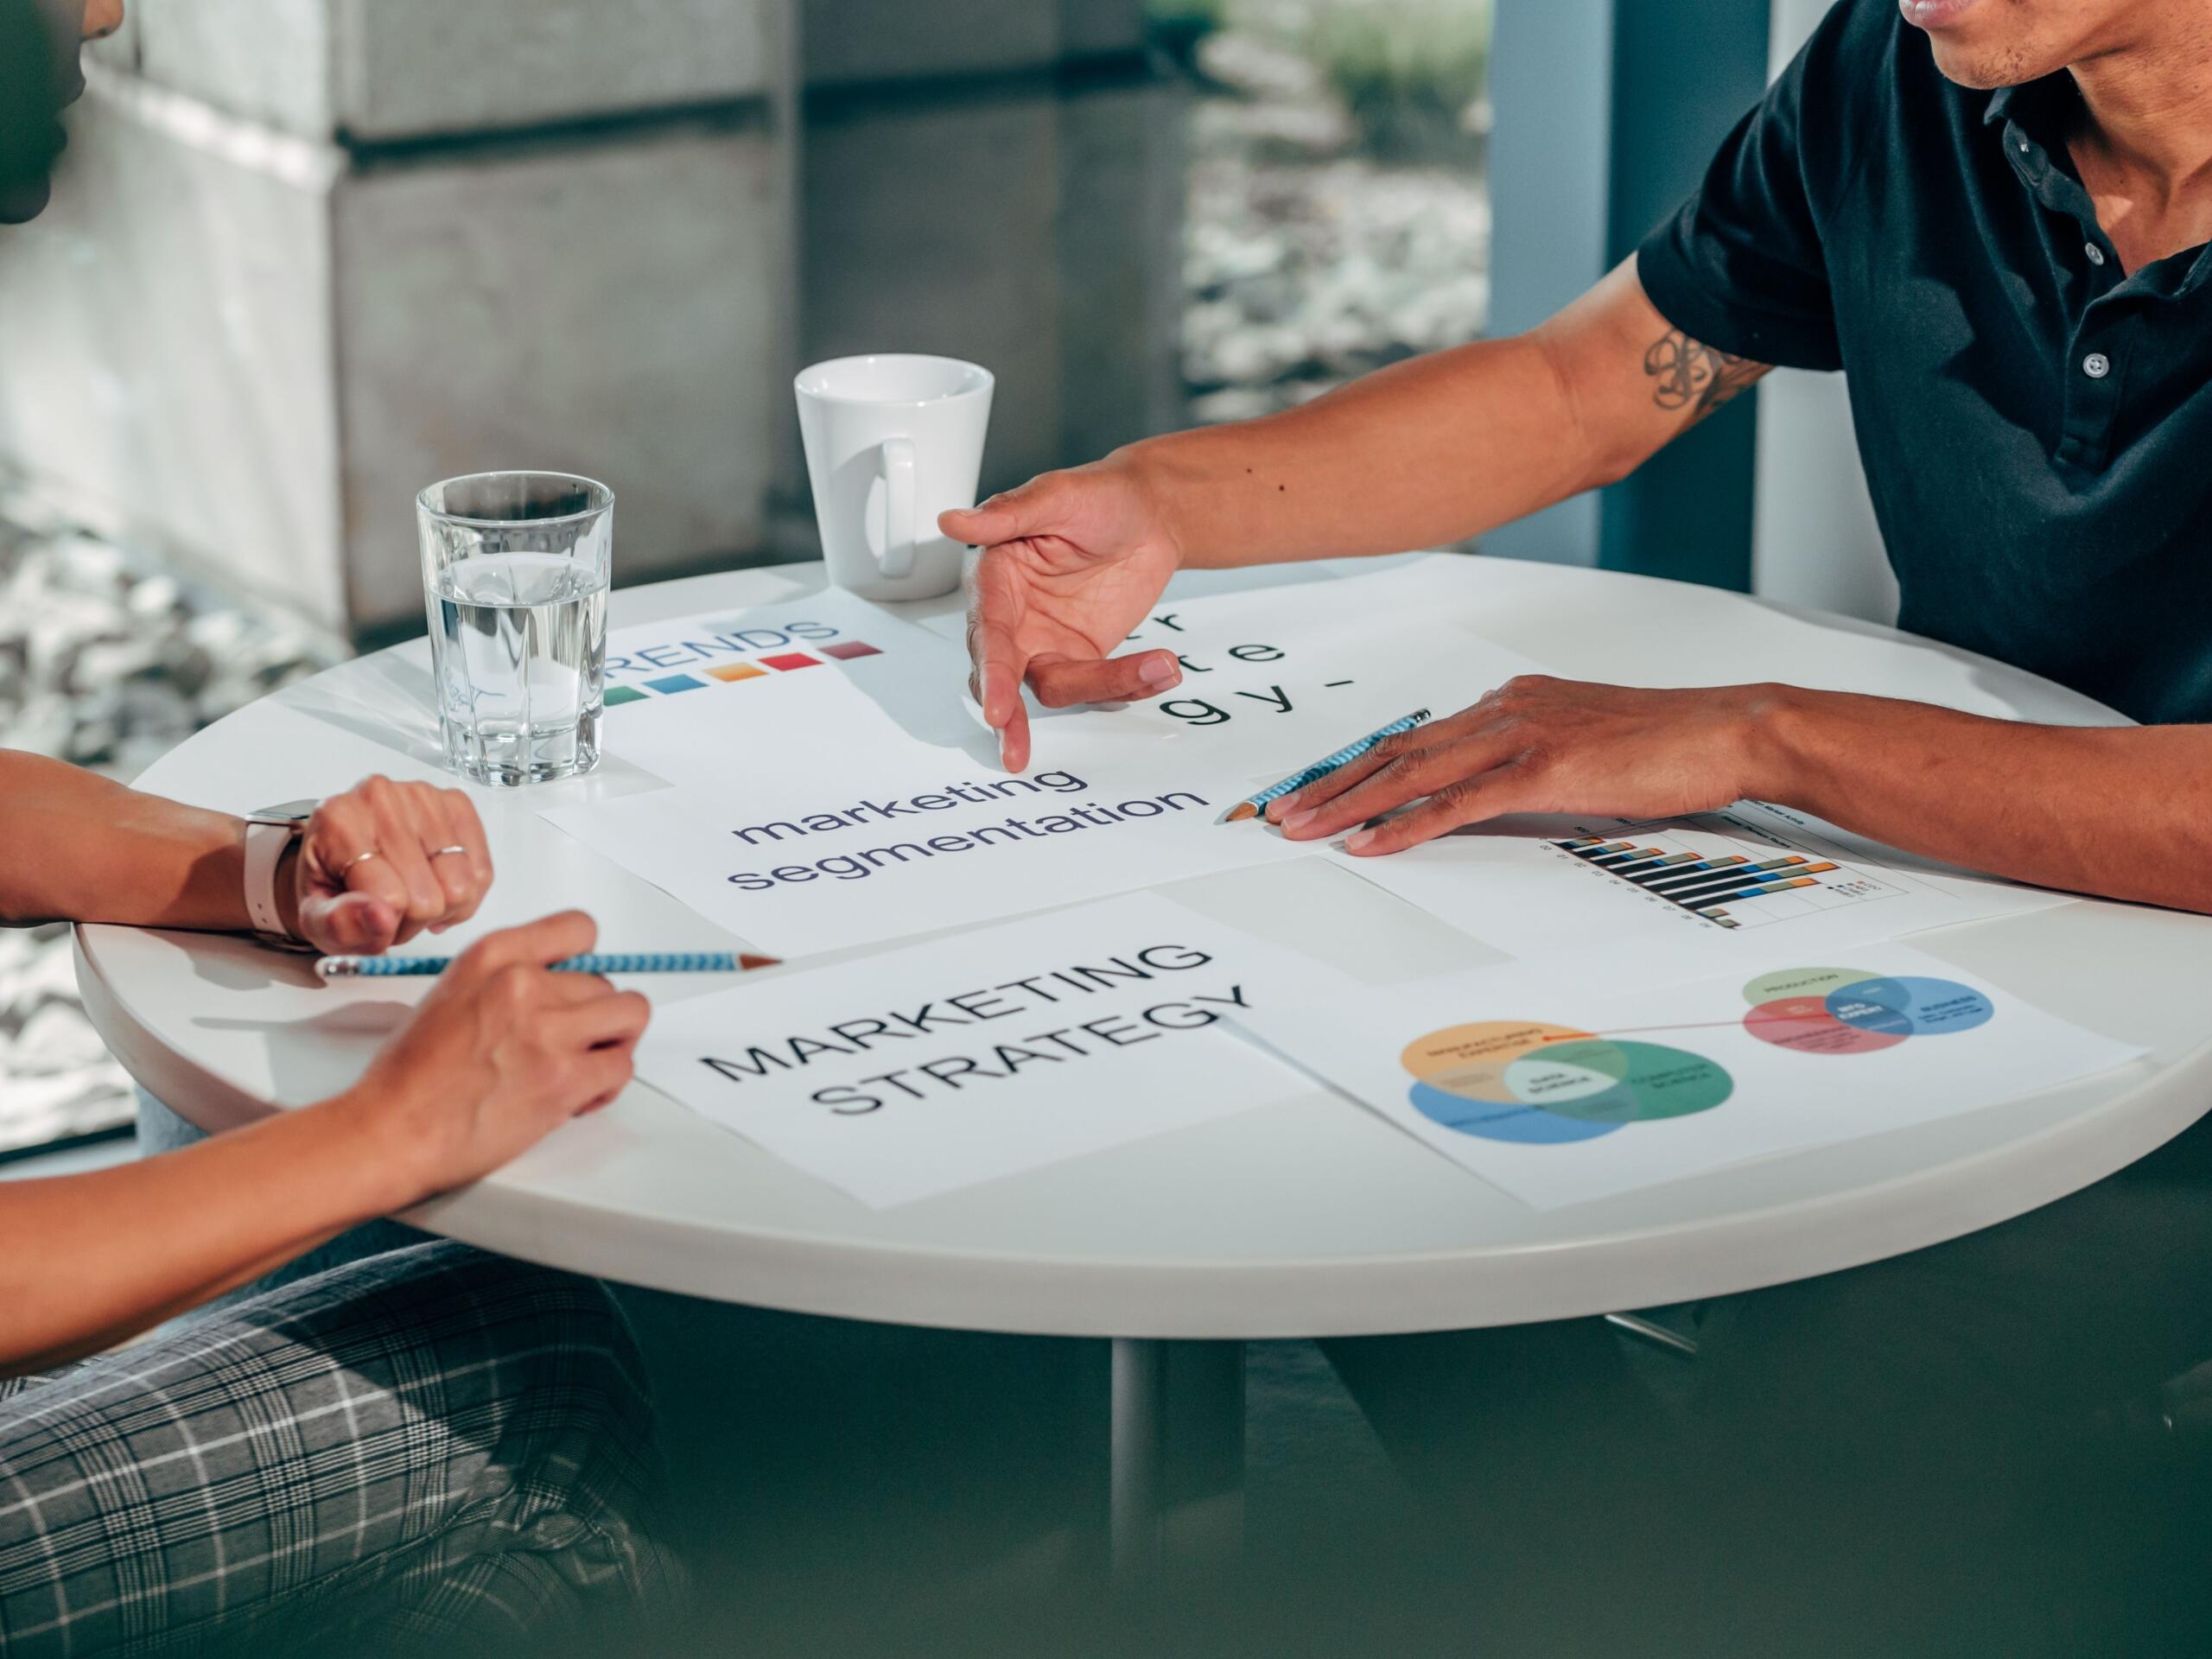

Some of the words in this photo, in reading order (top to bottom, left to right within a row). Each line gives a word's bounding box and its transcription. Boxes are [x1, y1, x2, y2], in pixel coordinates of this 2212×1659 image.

[605, 621, 839, 678] RENDS
[727, 792, 1210, 891] segmentation
[731, 770, 1088, 845] marketing
[698, 944, 1213, 1082] MARKETING
[810, 985, 1251, 1116] STRATEGY
